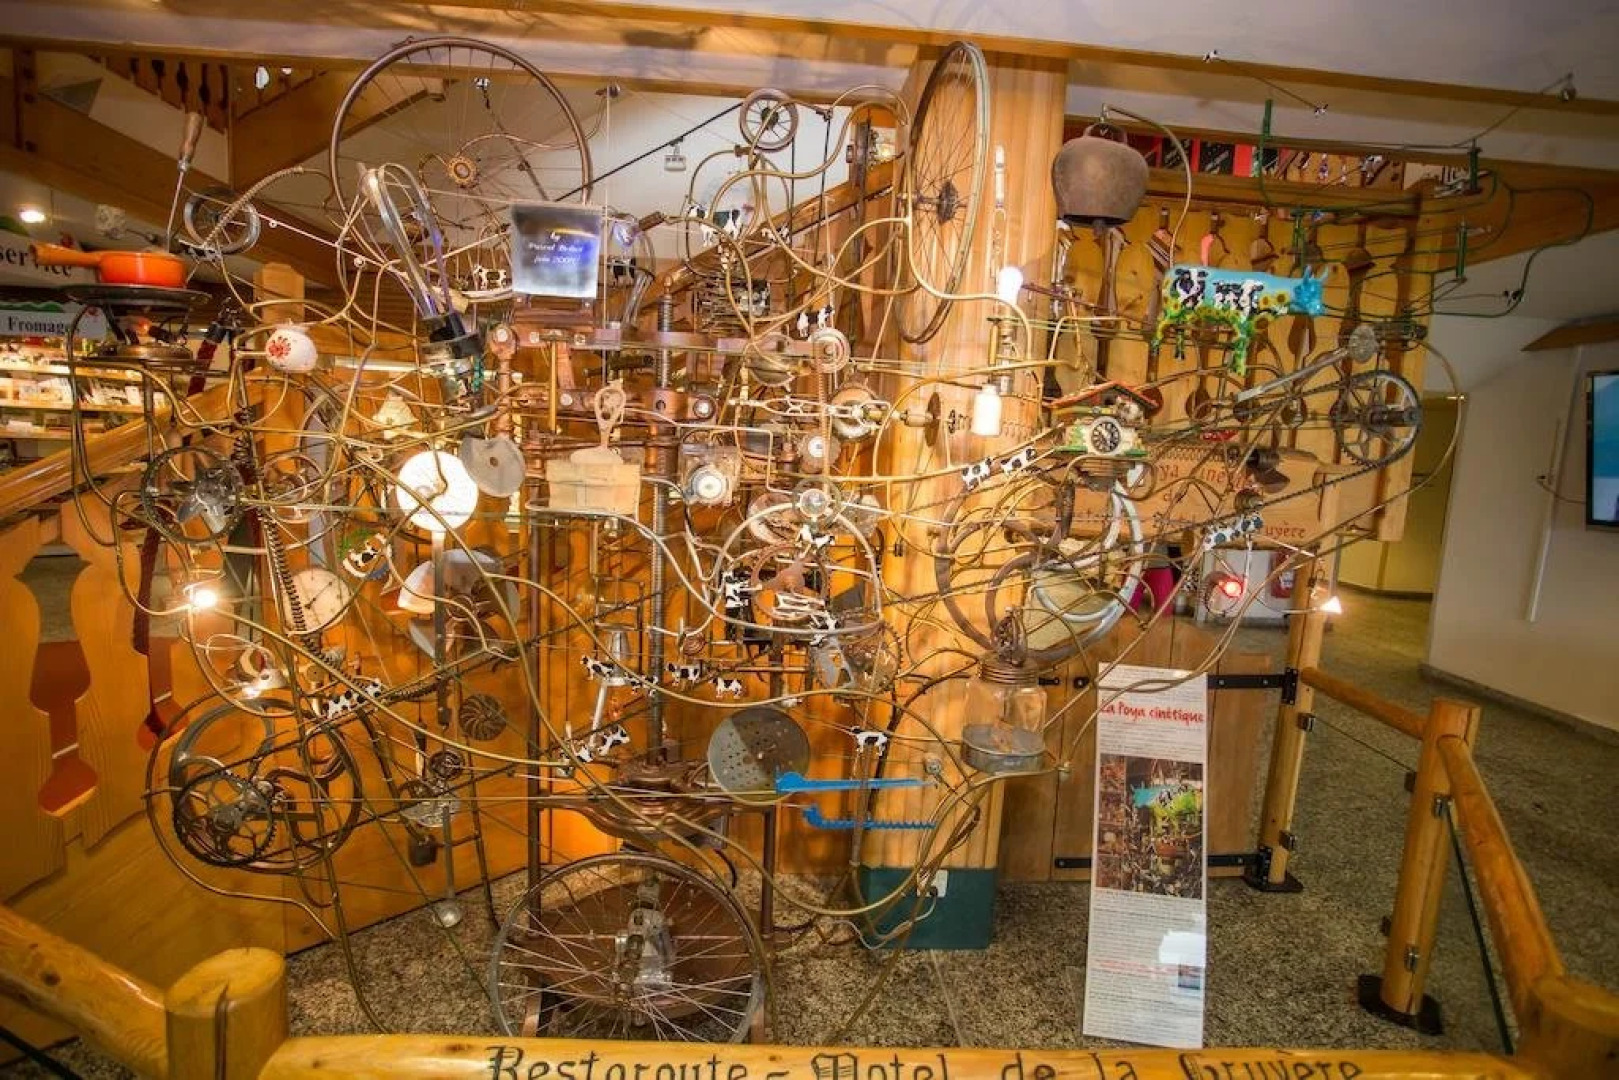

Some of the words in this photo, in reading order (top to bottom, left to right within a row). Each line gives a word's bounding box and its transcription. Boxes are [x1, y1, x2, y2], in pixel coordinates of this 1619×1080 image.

[1118, 702, 1146, 721] Poya
[1149, 706, 1204, 726] cinétique
[1002, 1051, 1057, 1080] de
